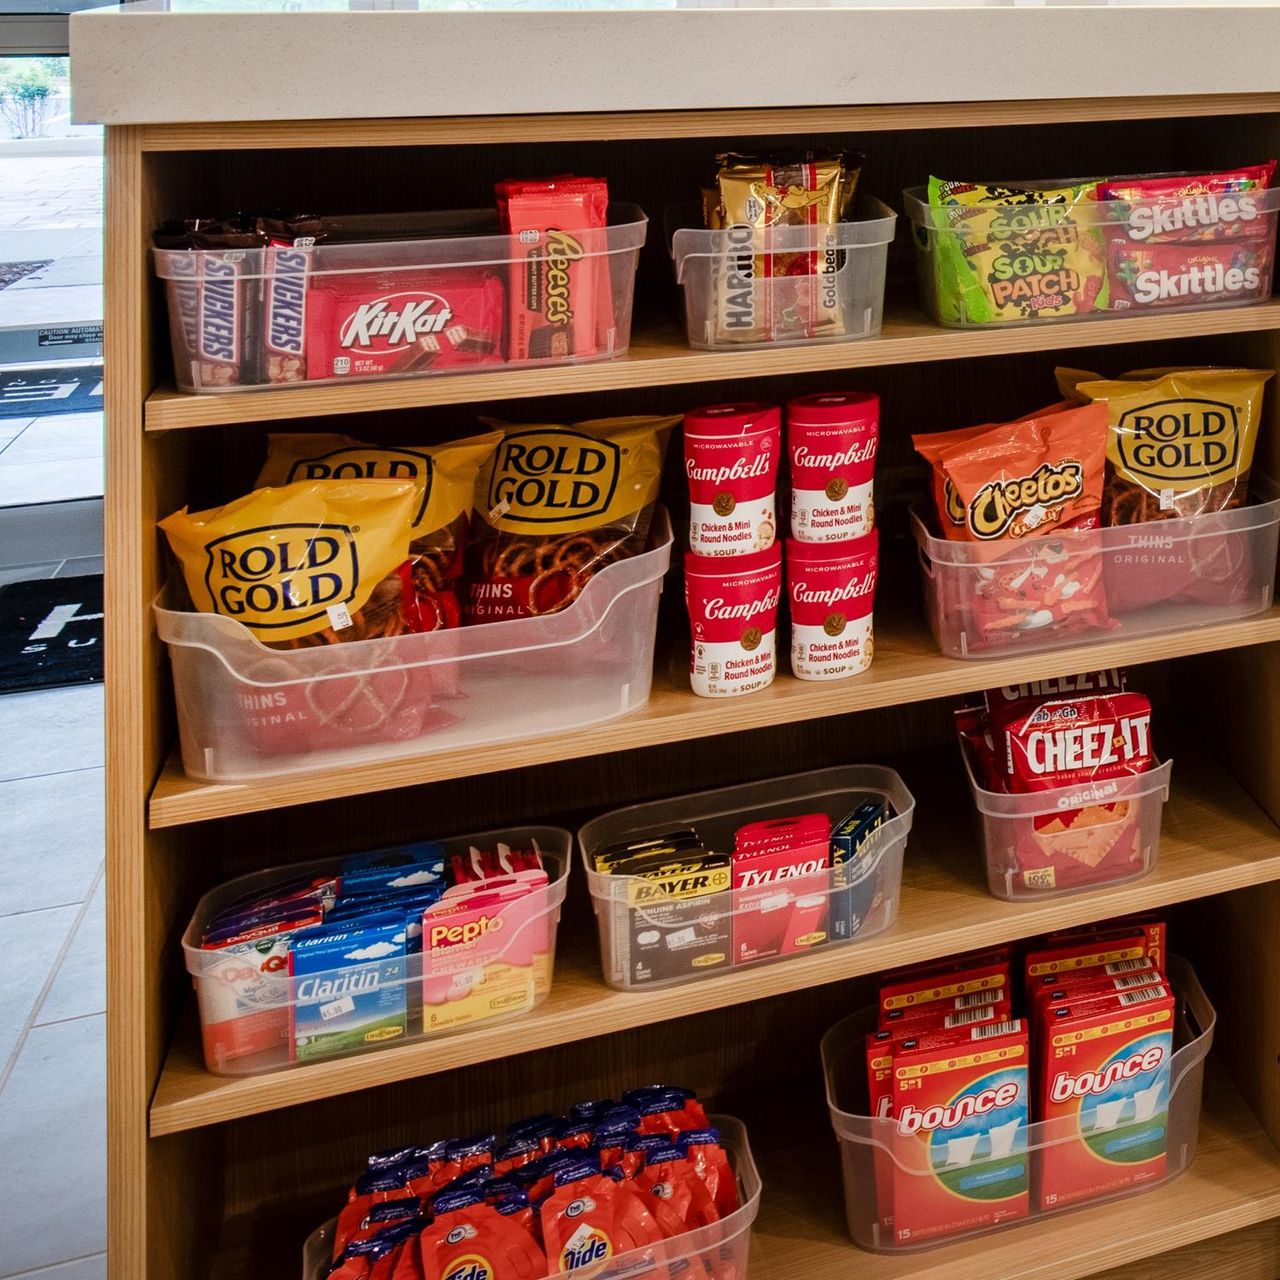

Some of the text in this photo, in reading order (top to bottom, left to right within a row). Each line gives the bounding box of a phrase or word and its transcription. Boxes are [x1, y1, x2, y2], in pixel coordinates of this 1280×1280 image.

[1128, 195, 1258, 240] Skittles
[546, 228, 585, 325] Reese's
[725, 224, 754, 329] HARIBO
[822, 233, 837, 309] Goldbears
[993, 254, 1065, 280] SOUR
[991, 271, 1079, 307] PATCH
[1134, 263, 1260, 304] Skittles
[203, 258, 235, 362] SNICKERS
[269, 250, 307, 353] SNICKERS
[1030, 294, 1063, 310] Kids
[334, 358, 350, 367] 210
[806, 425, 866, 437] MICROWAVABLE
[1133, 411, 1226, 442] ROLD
[693, 440, 754, 450] MICROWAVABLE
[793, 437, 877, 472] Campbell's
[1133, 441, 1227, 468] GOLD
[502, 444, 607, 477] ROLD
[685, 453, 771, 486] Campbell's
[494, 477, 600, 508] GOLD
[973, 464, 1080, 537] Cheetos
[810, 514, 863, 528] Round Noodles
[811, 504, 862, 518] Chicken Mini
[701, 519, 751, 533] Chicken Mini
[825, 531, 849, 541] SOUP
[700, 531, 753, 544] Round Noodles
[1128, 535, 1174, 549] THINS
[220, 536, 340, 582] ROLD
[713, 548, 738, 557] SOUP
[1114, 555, 1185, 564] ORIGINAL
[804, 560, 865, 573] MICROWAVABLE
[470, 583, 513, 598] THINS
[722, 571, 778, 588] MICROWAVABLE
[791, 571, 876, 607] Campbell's
[219, 572, 343, 615] GOLD
[725, 651, 772, 670] Chicken Mini
[823, 665, 847, 675] SOUP
[724, 663, 773, 681] Round Noodles
[740, 681, 762, 692] SOUP
[737, 844, 791, 861] TYLENOL
[738, 857, 826, 891] TYLENOL
[635, 875, 710, 900] BAYER
[676, 898, 711, 911] ASPIRIN
[297, 933, 348, 949] Claritin
[431, 915, 504, 947] Pepto
[740, 942, 748, 952] 6
[297, 966, 400, 1003] Claritin 24
[323, 1004, 343, 1020] $5.00
[1052, 1049, 1163, 1101] bounce
[899, 1083, 1019, 1135] bounce
[1045, 1193, 1059, 1205] 15
[898, 1228, 912, 1239] 15
[564, 1239, 607, 1271] Tide
